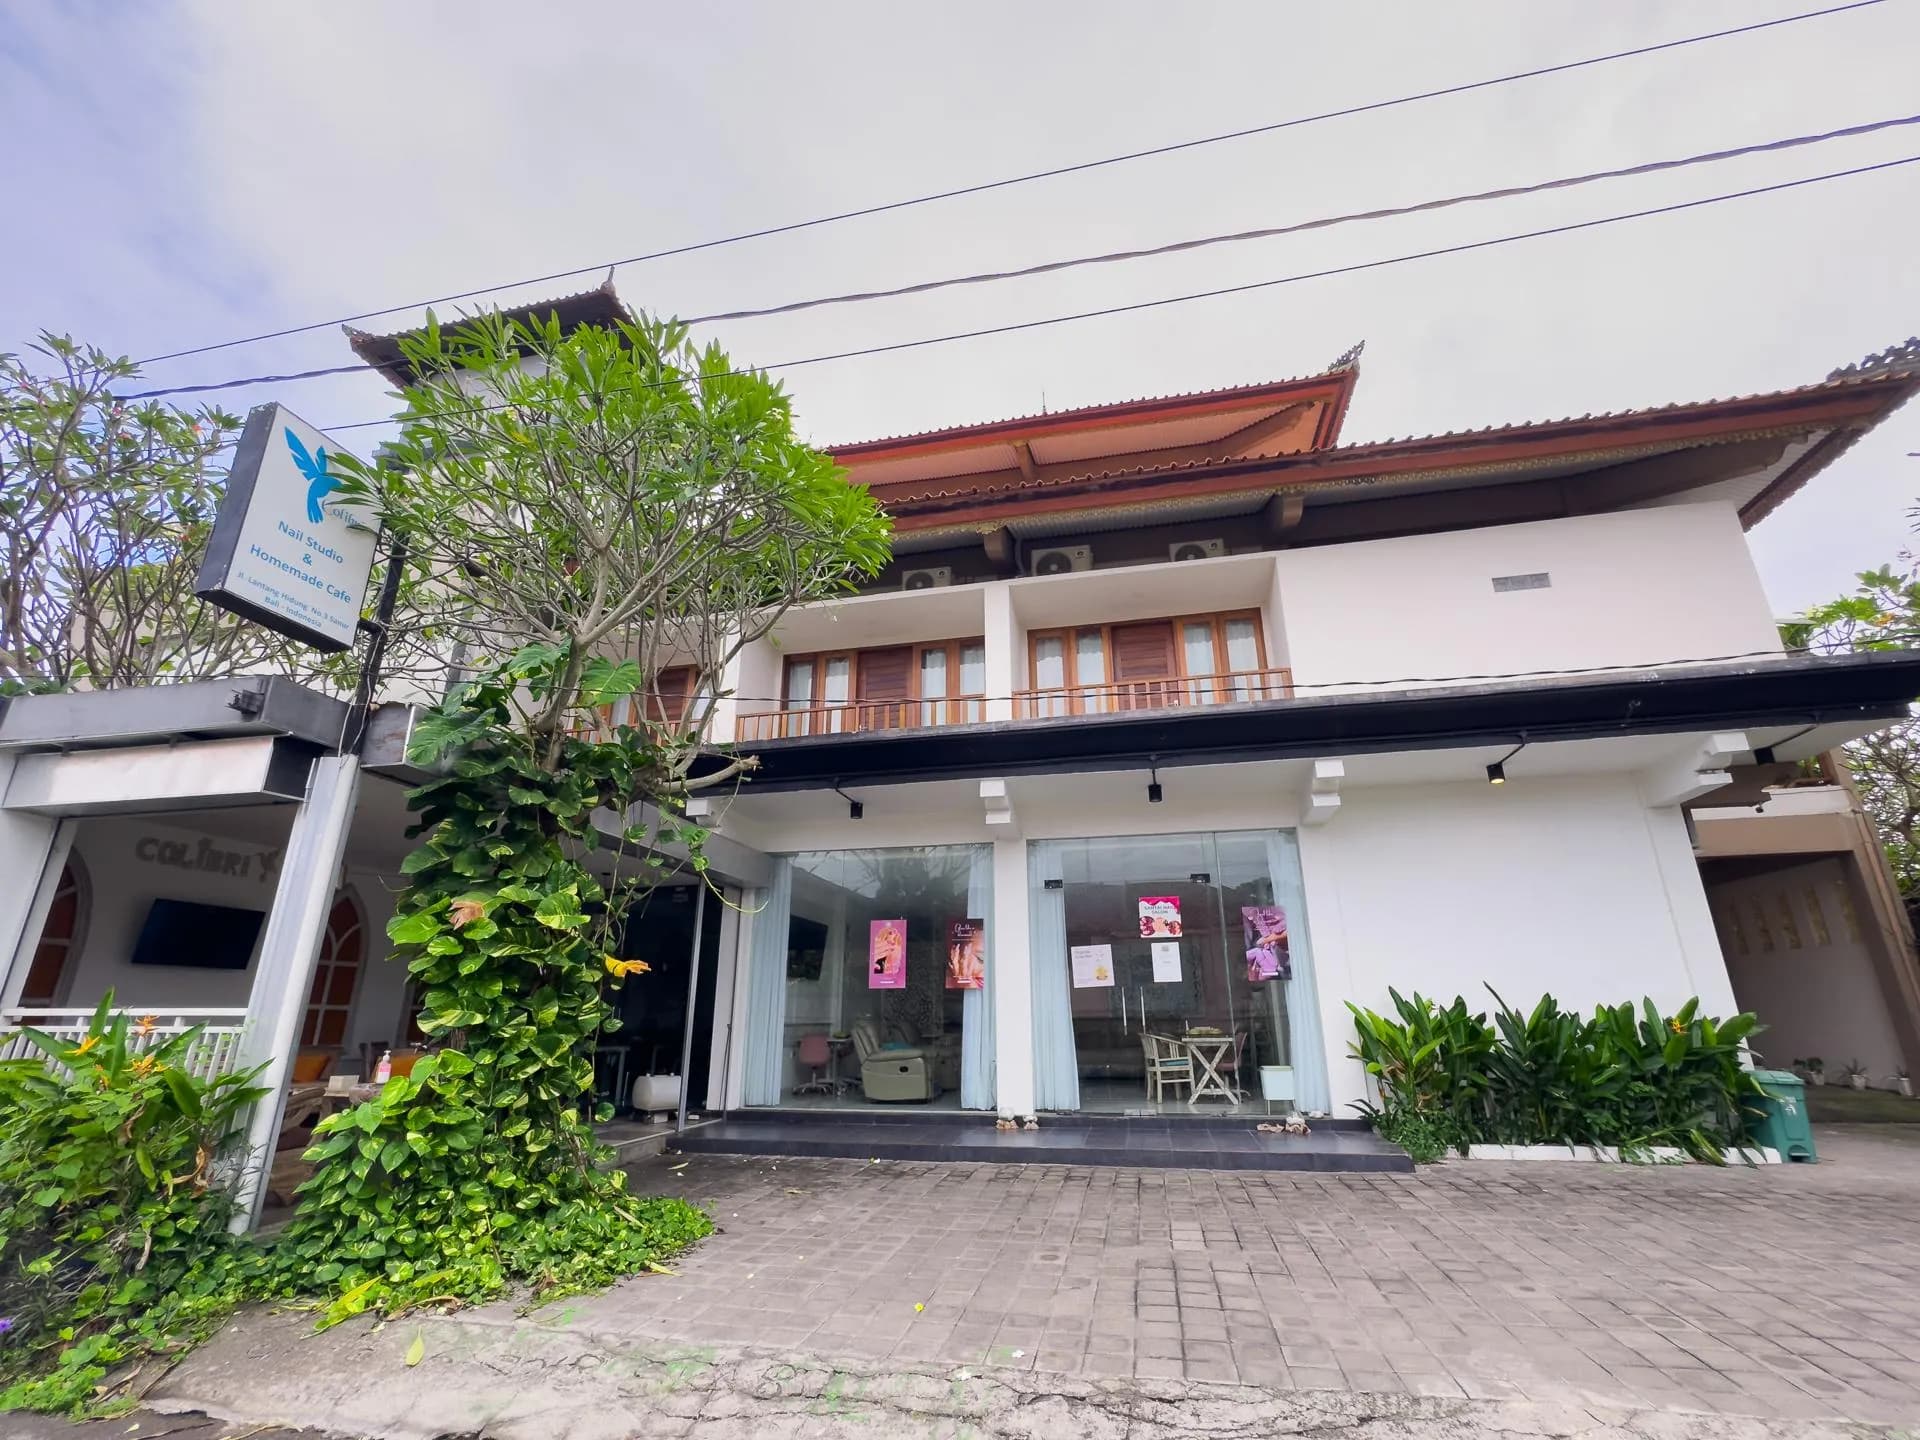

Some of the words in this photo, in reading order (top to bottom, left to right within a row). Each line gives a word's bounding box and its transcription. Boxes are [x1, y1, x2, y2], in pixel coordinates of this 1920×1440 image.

[278, 520, 303, 542] Nail
[305, 536, 344, 564] Studio
[302, 553, 313, 567] &
[249, 543, 324, 589] Homemade
[326, 584, 352, 604] Cafe
[264, 596, 280, 608] Bali
[286, 607, 322, 628] Indonesia
